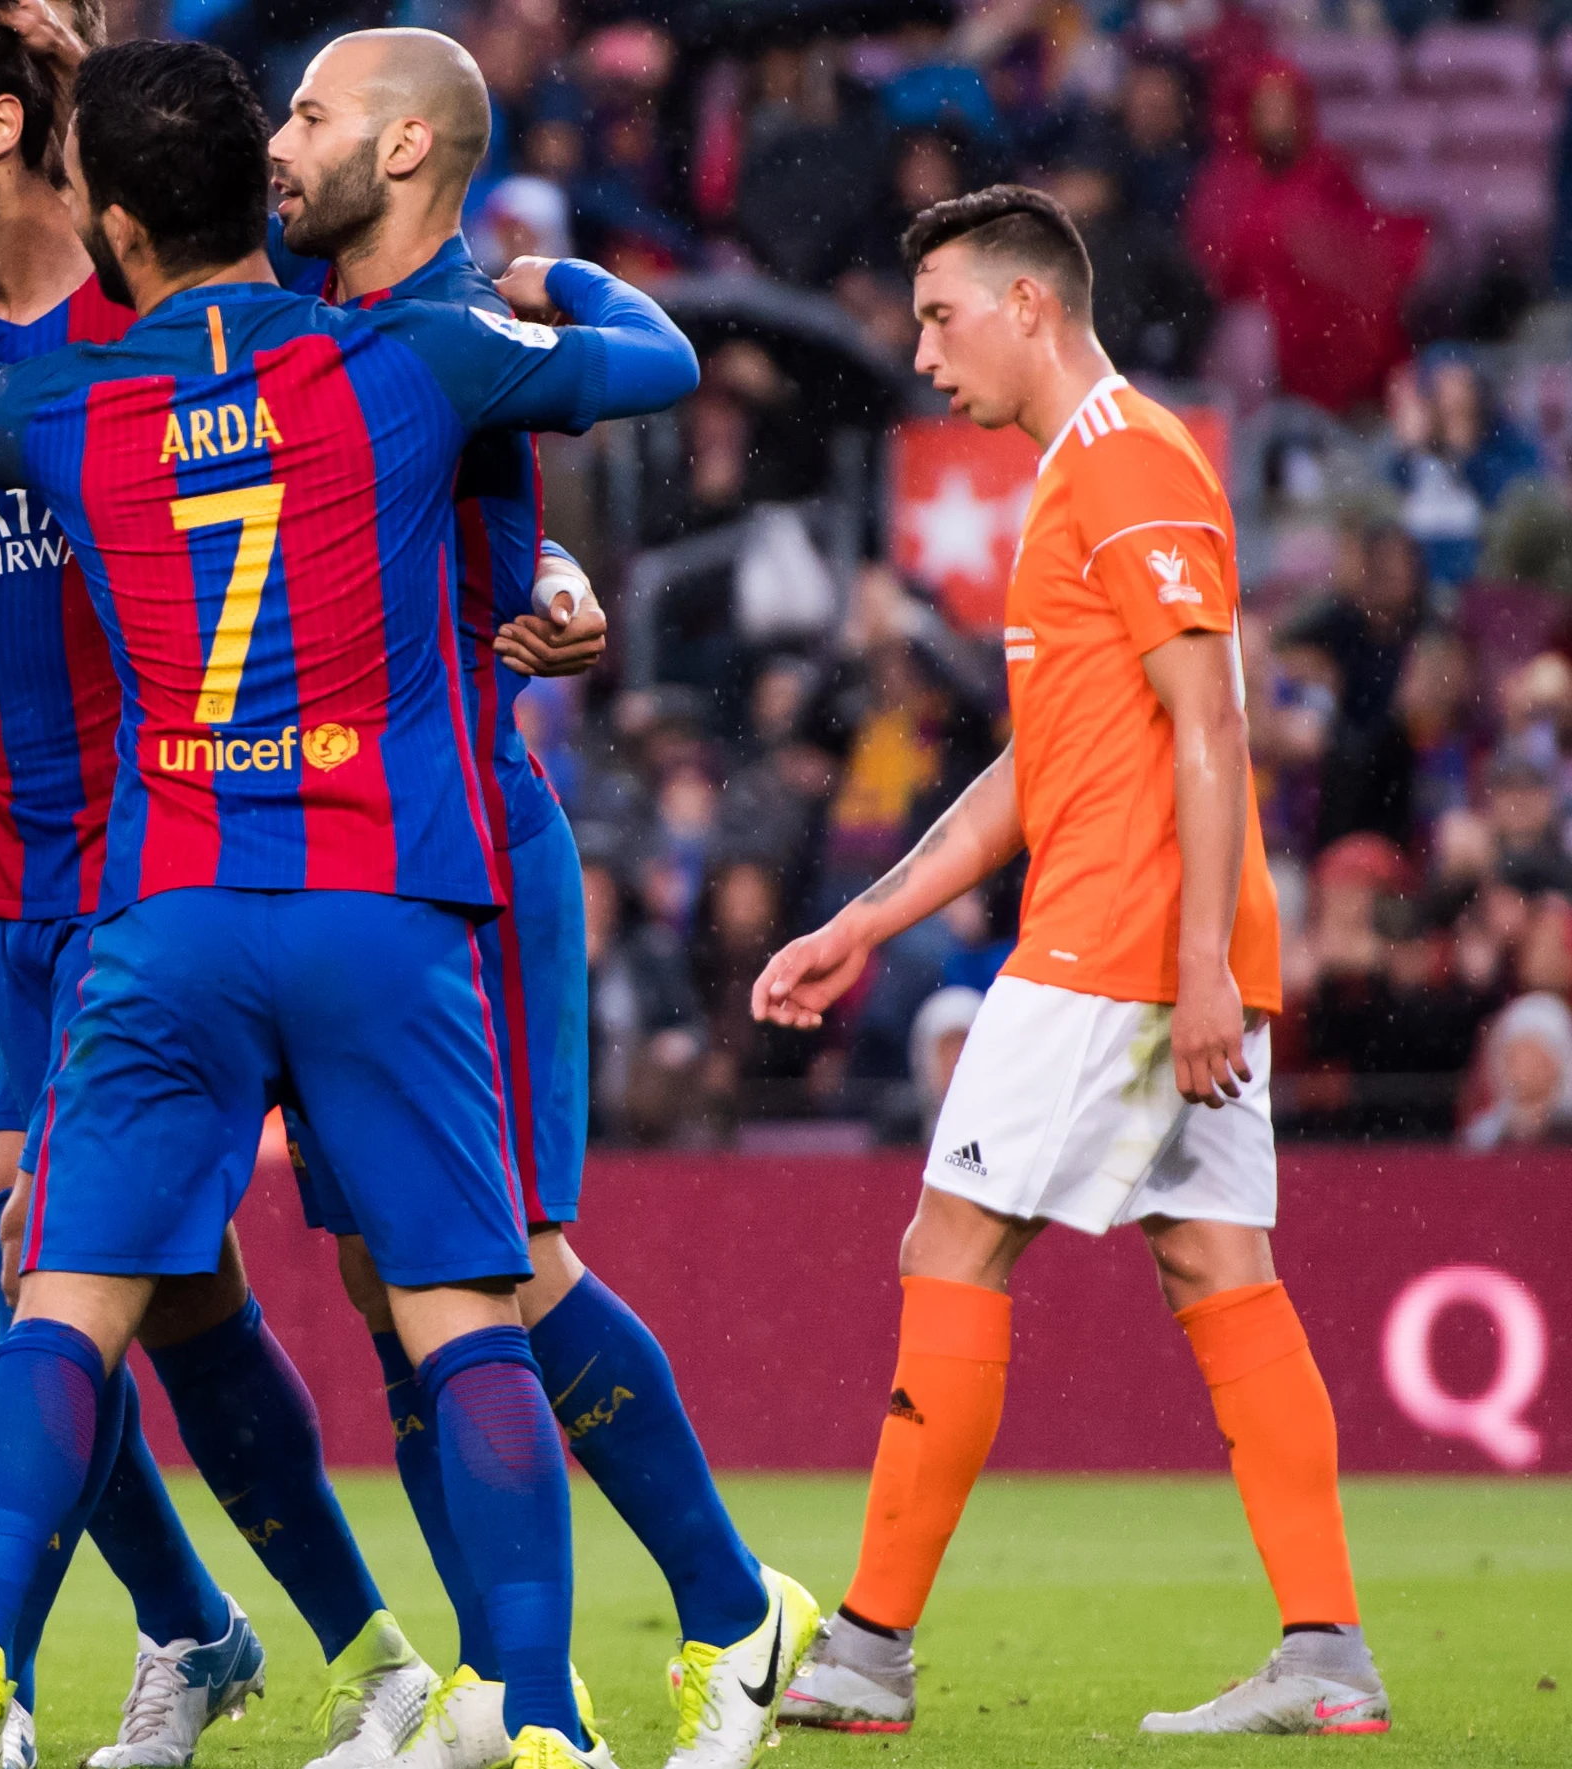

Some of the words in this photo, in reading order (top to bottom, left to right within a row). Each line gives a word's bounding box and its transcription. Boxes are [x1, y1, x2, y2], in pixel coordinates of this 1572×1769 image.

[159, 397, 284, 464] ARDA
[169, 483, 286, 723] 7
[158, 725, 298, 773] unicef
[944, 1154, 988, 1177] adidas
[1383, 1266, 1549, 1468] Q
